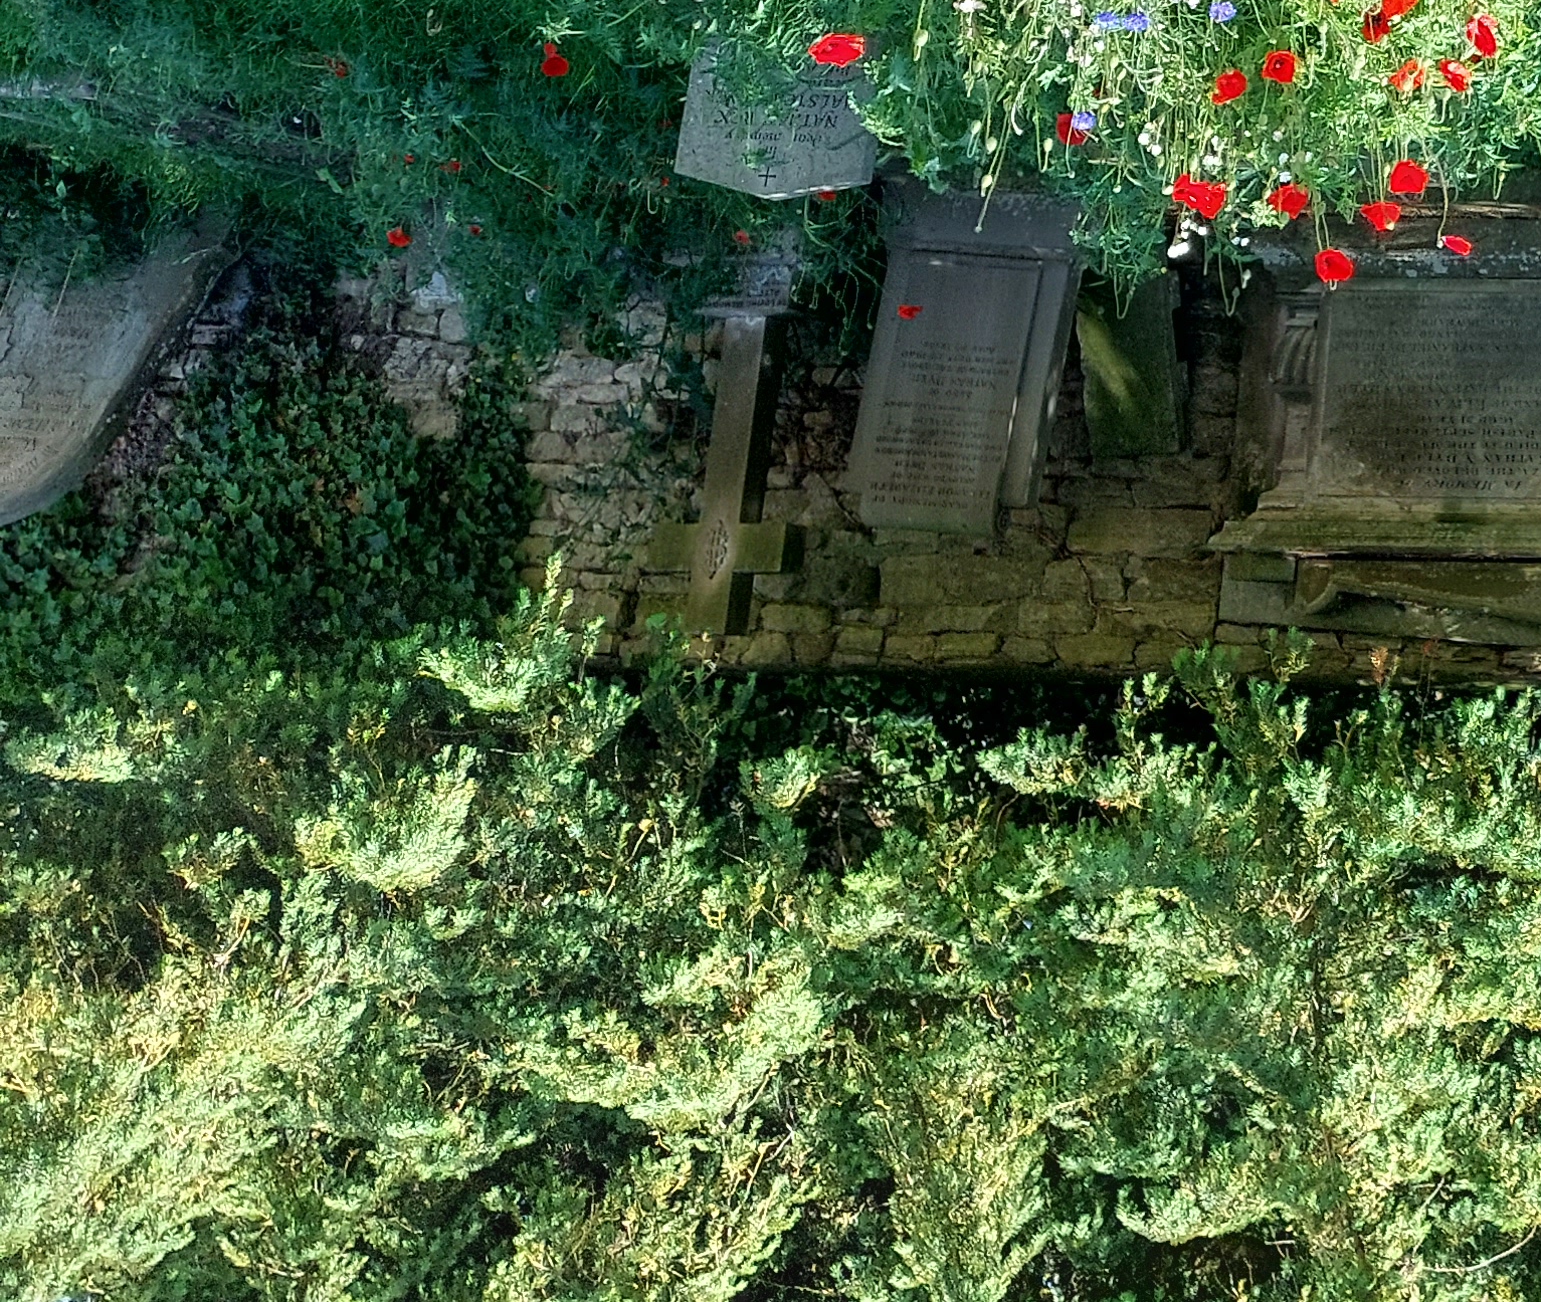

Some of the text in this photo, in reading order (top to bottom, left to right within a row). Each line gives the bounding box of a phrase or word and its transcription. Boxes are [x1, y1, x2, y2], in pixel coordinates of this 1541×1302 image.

[949, 377, 997, 391] NATHAN
[1480, 428, 1536, 440] PARISH
[1411, 465, 1480, 476] BELOVED
[1423, 479, 1496, 491] MEMORY
